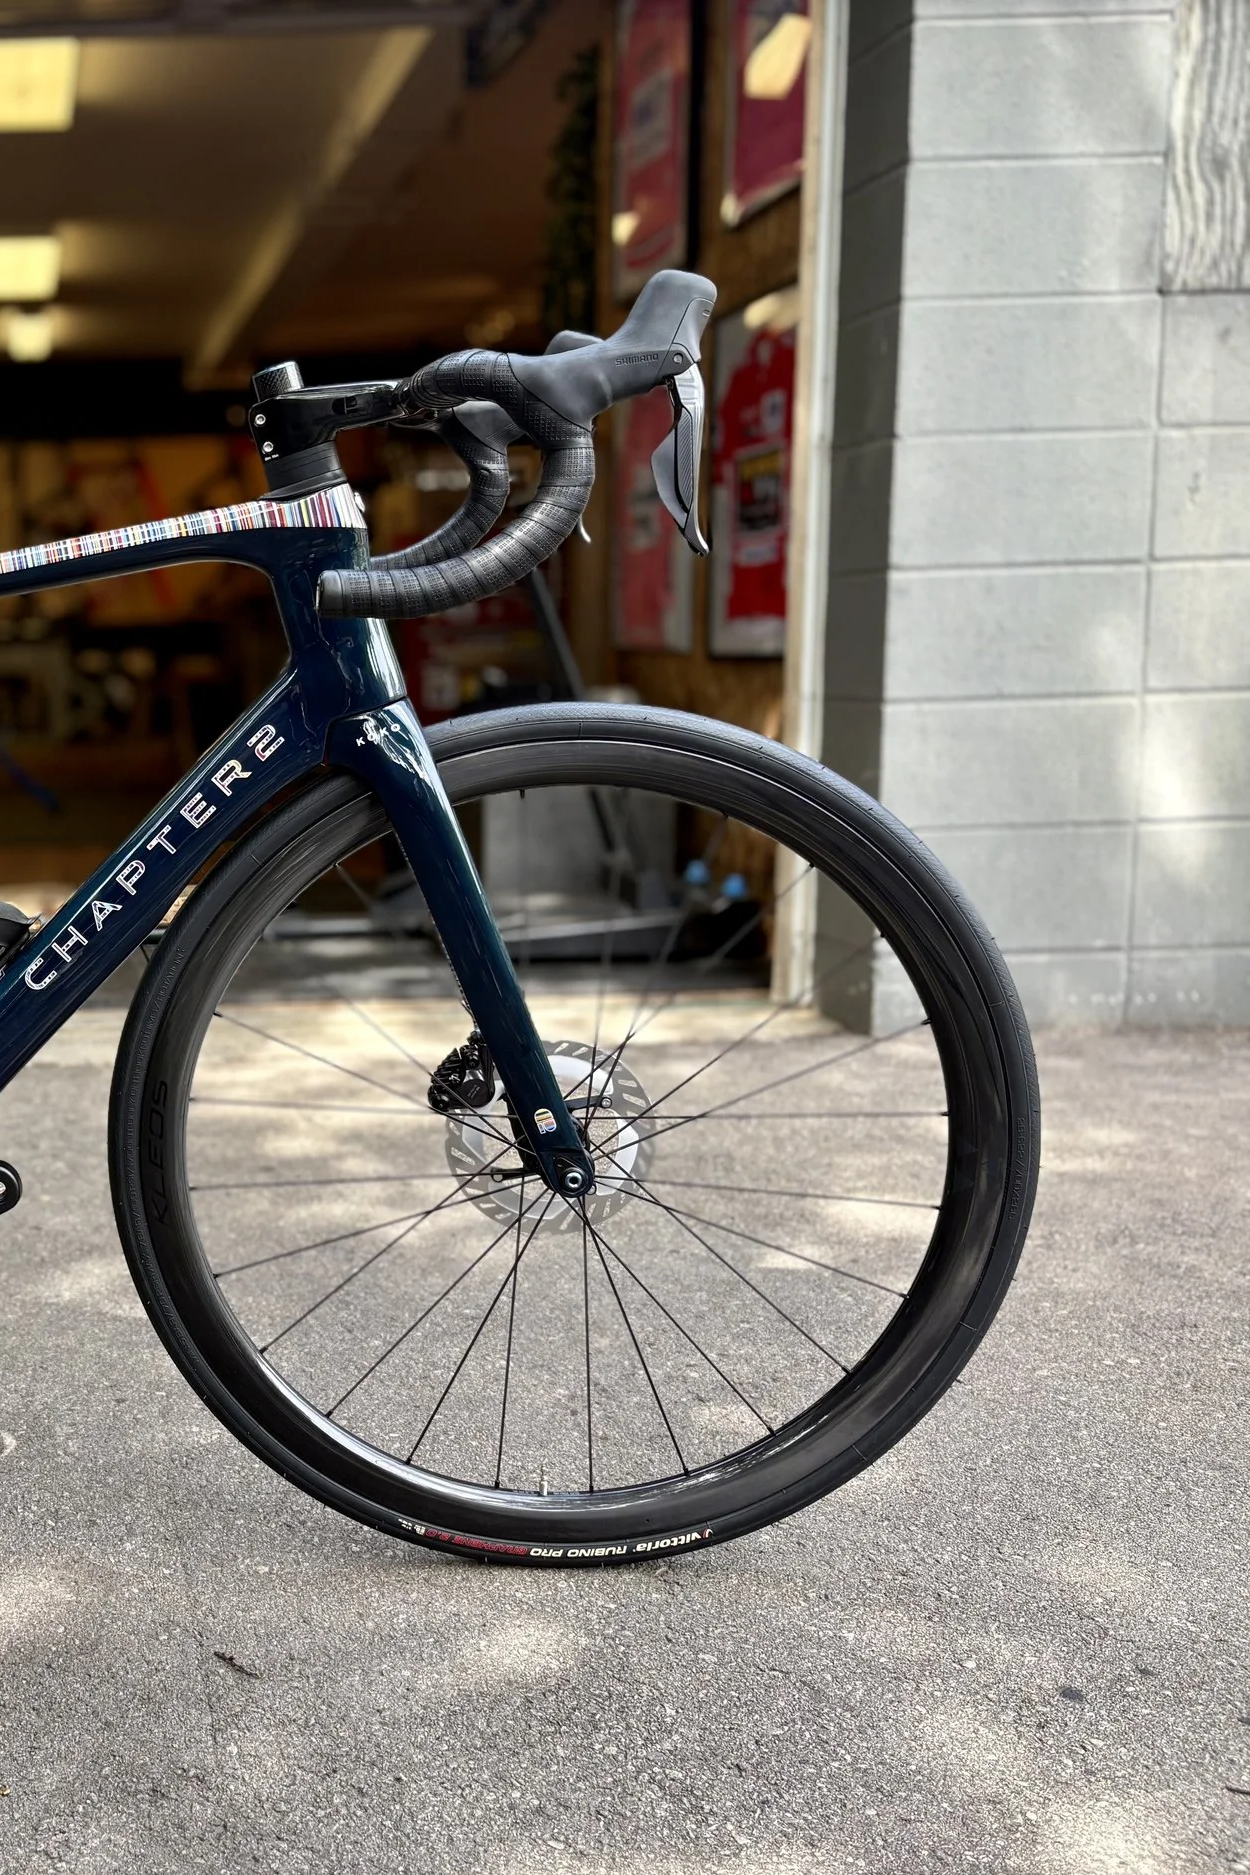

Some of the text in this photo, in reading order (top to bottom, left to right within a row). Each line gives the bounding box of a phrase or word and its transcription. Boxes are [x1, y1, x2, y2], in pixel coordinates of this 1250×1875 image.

[614, 353, 659, 367] SHIMANO
[149, 1080, 169, 1225] KLEOS
[529, 1547, 564, 1558] PRO
[567, 1545, 627, 1558] RUBINO
